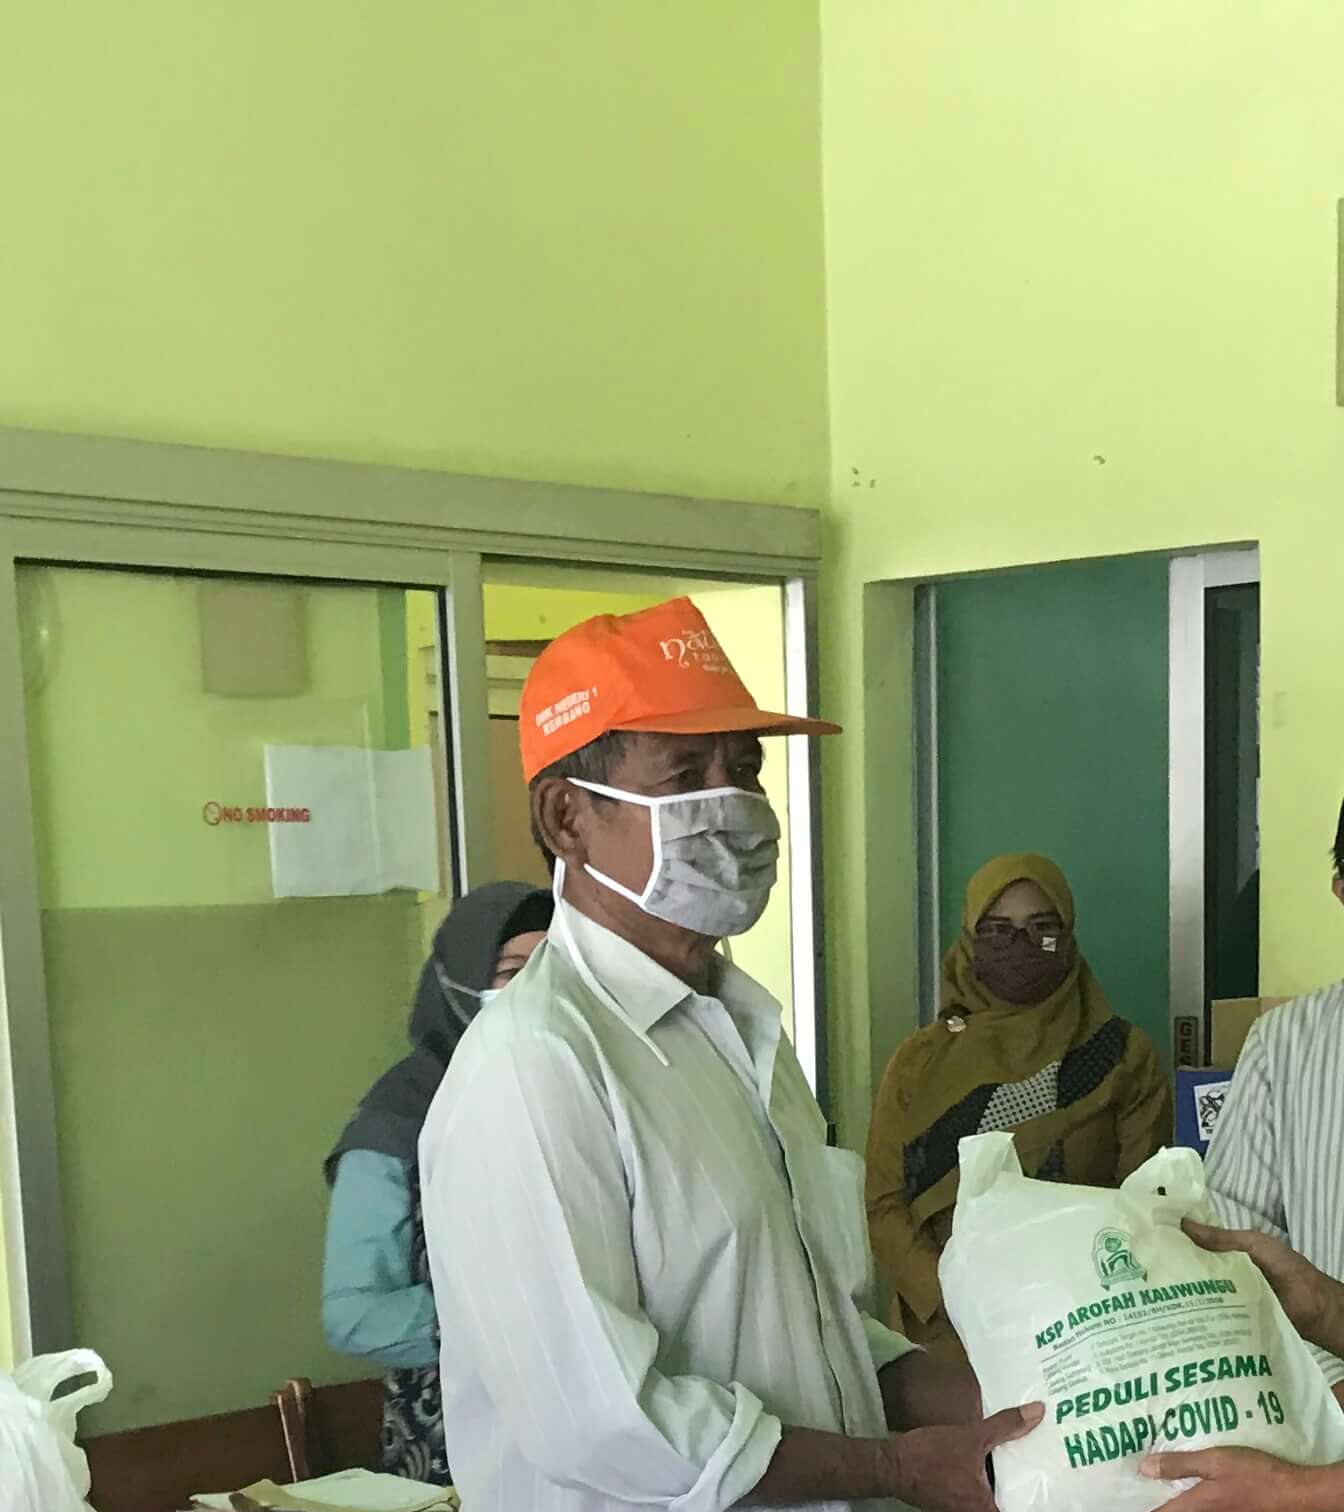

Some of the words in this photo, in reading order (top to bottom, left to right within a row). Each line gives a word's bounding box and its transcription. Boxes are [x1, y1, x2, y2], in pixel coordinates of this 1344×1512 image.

[222, 807, 242, 822] NO
[246, 807, 311, 823] SMOKING
[1035, 1320, 1065, 1349] KSP
[1067, 1291, 1136, 1330] AROFAH
[1138, 1279, 1237, 1306] KALIWUNGU
[1056, 1372, 1158, 1425] PEDULI
[1164, 1355, 1272, 1393] SESAMA
[1064, 1414, 1156, 1469] HADAPI
[1161, 1395, 1239, 1442] COVID
[1256, 1390, 1285, 1426] 19
